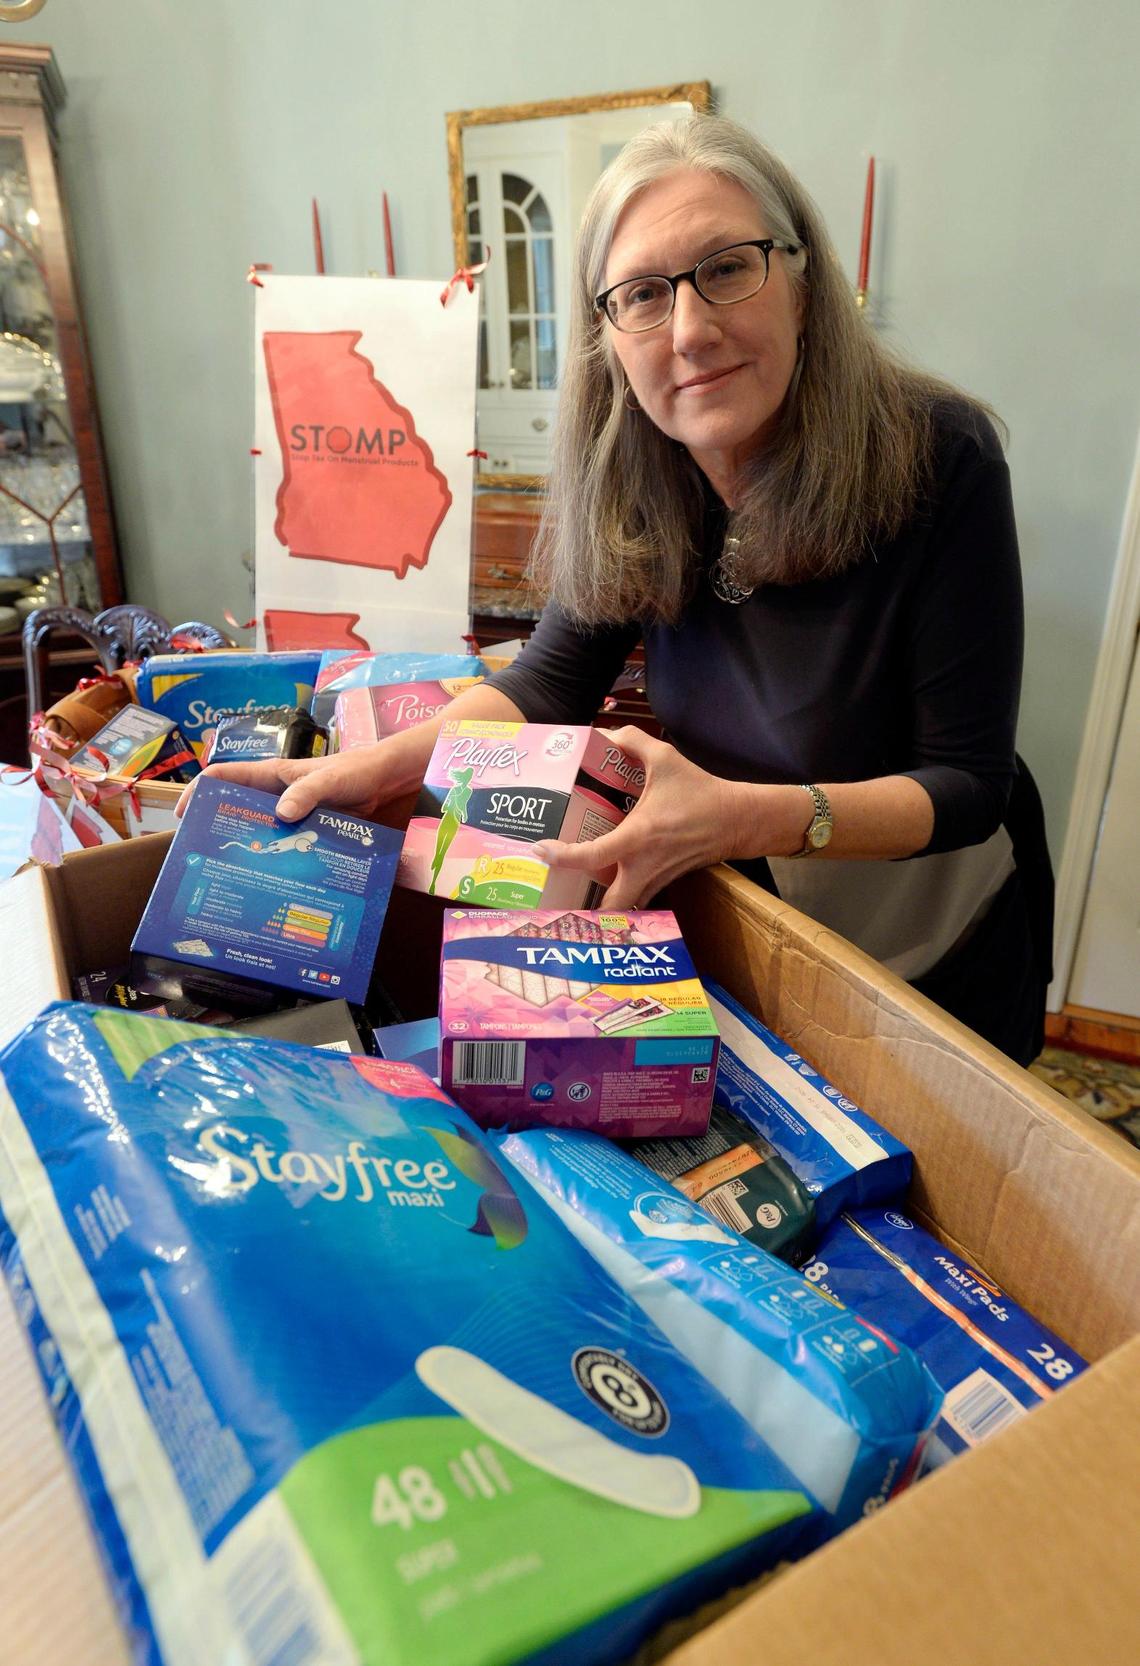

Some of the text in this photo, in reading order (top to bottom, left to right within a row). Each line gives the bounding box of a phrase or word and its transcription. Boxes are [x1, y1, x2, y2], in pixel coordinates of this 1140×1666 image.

[290, 424, 406, 455] STOMP
[341, 456, 381, 465] Menstrual
[382, 458, 419, 466] Products
[217, 736, 269, 752] Stayfree
[443, 737, 528, 777] Playtex
[218, 802, 275, 823] LEAKGUARD
[486, 793, 552, 820] SPORT
[318, 813, 374, 838] TAMPAX
[461, 878, 472, 895] S
[486, 886, 498, 901] 25
[516, 946, 676, 965] TAMPAX
[604, 964, 678, 977] radiant
[535, 1088, 553, 1097] P&G
[171, 1125, 456, 1203] Stayfree
[386, 1187, 445, 1208] maxi
[934, 1255, 1010, 1322] Maxi Pads
[1027, 1343, 1075, 1381] 28
[372, 1464, 448, 1531] 48
